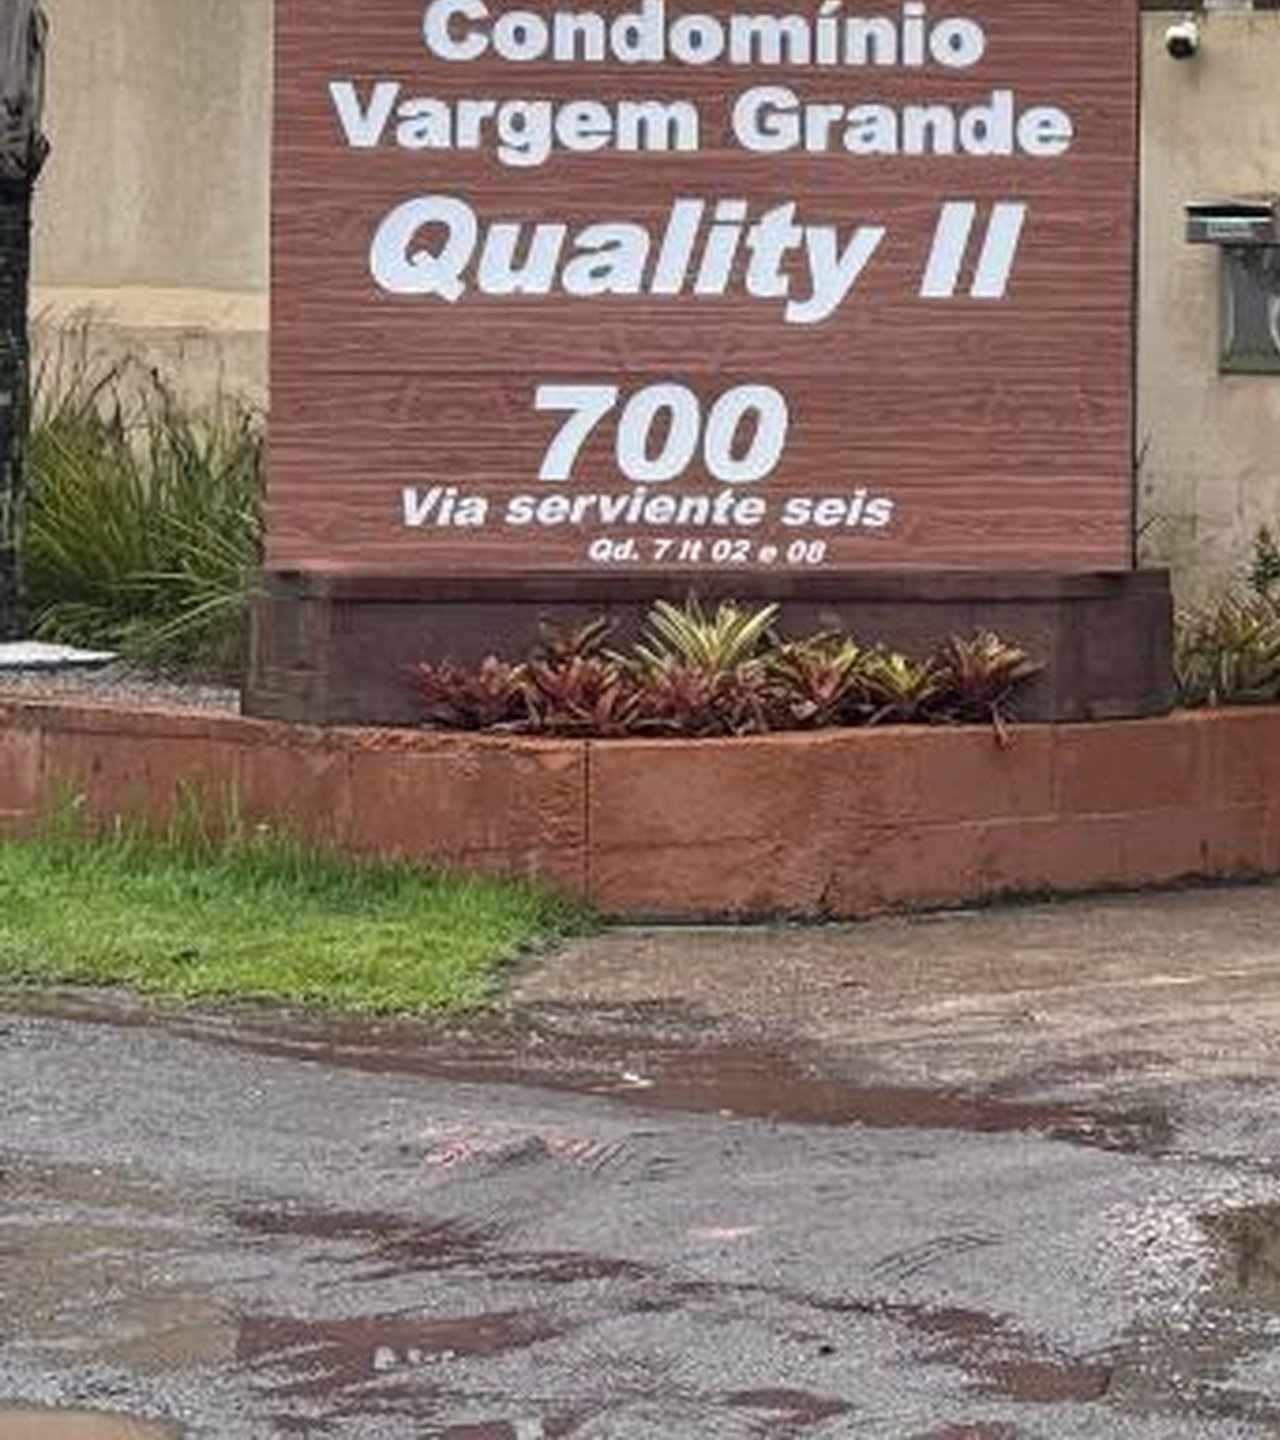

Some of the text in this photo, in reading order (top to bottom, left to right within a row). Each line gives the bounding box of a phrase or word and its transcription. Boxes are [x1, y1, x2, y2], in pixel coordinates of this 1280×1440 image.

[329, 82, 1073, 167] Vargem Grande
[369, 195, 1026, 324] Quality II
[535, 383, 788, 484] 700
[403, 485, 894, 527] Via serviente seis
[588, 537, 639, 563] Qd.
[653, 538, 675, 561] 7
[711, 538, 752, 563] 02
[758, 545, 778, 564] e
[786, 539, 827, 564] 08
